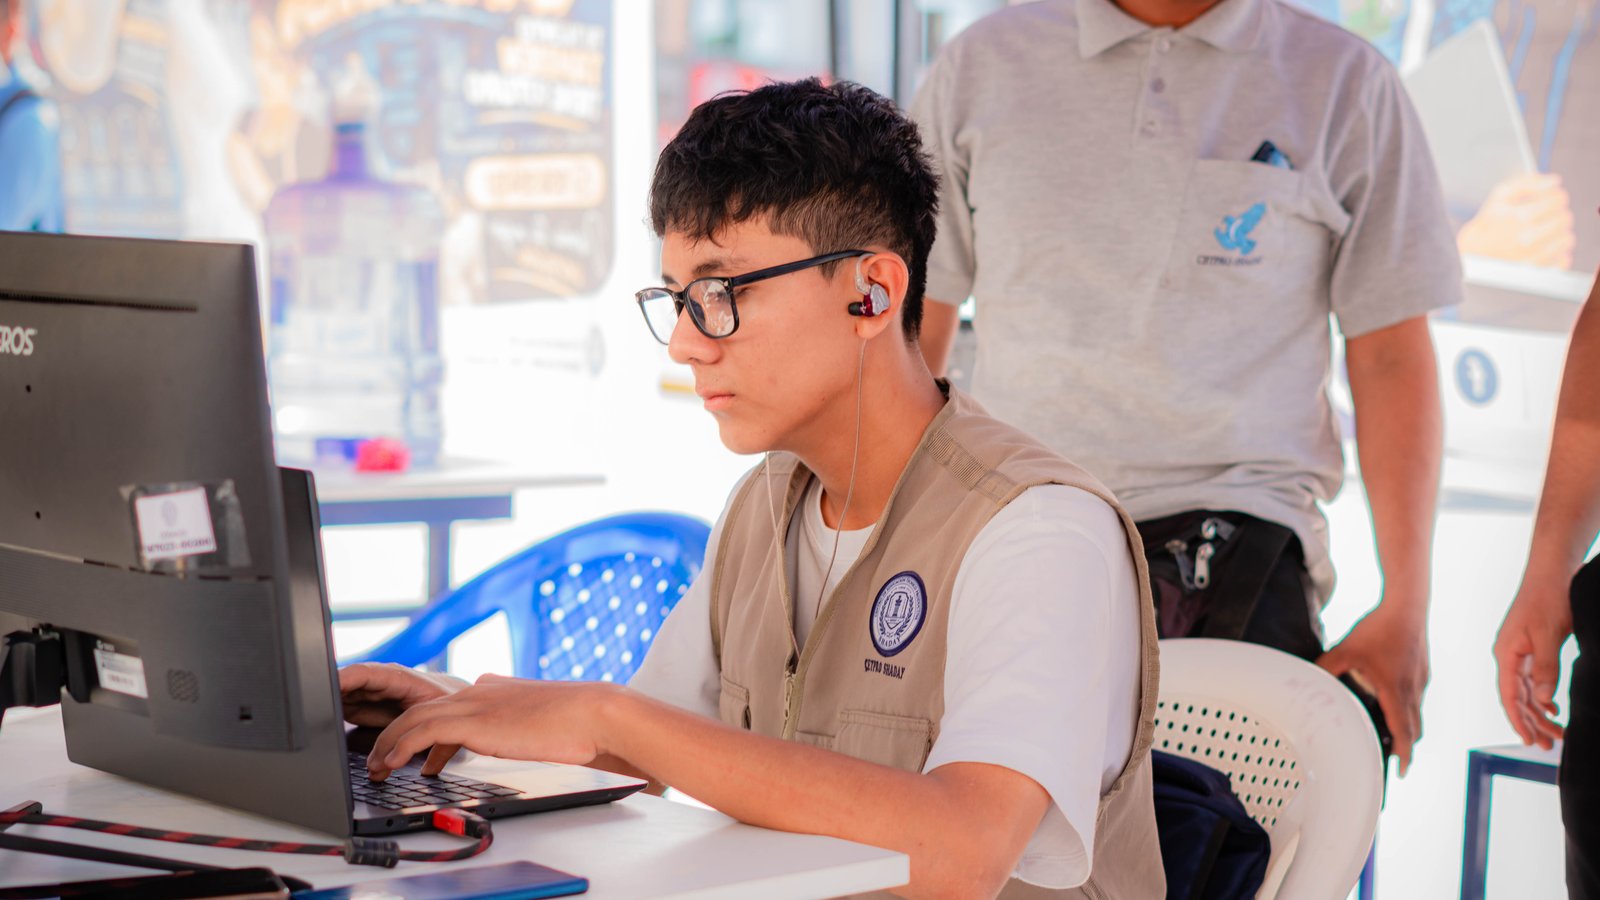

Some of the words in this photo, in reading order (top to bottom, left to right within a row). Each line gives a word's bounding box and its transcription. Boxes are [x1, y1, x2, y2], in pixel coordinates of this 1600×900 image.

[0, 325, 37, 356] ROS
[864, 659, 883, 673] CETPRO
[883, 663, 905, 680] SHADAY
